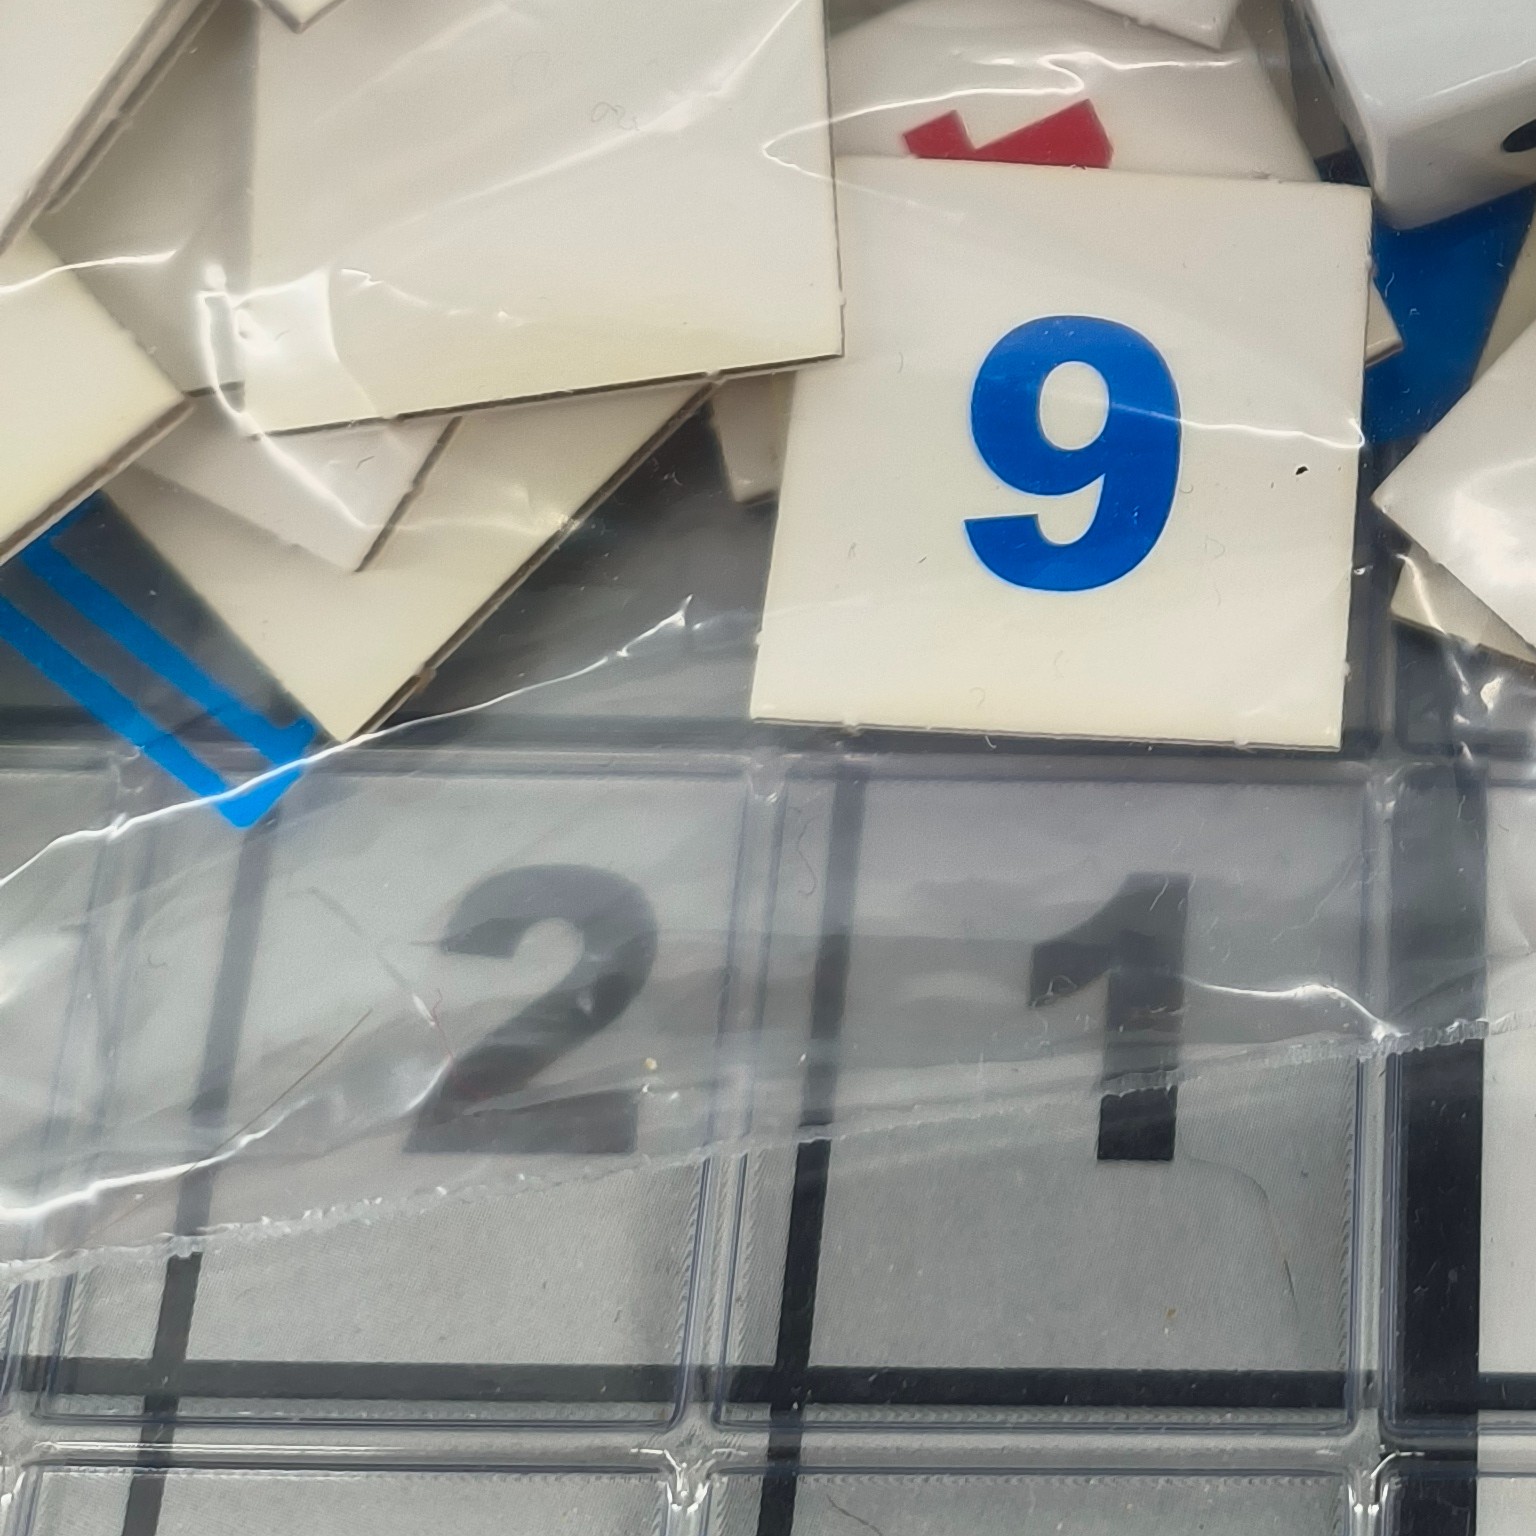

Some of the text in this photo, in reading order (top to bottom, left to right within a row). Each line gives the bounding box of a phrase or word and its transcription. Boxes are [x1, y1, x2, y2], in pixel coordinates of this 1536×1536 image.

[963, 315, 1181, 592] 9
[404, 863, 658, 1155] 2
[1028, 872, 1189, 1161] 1
